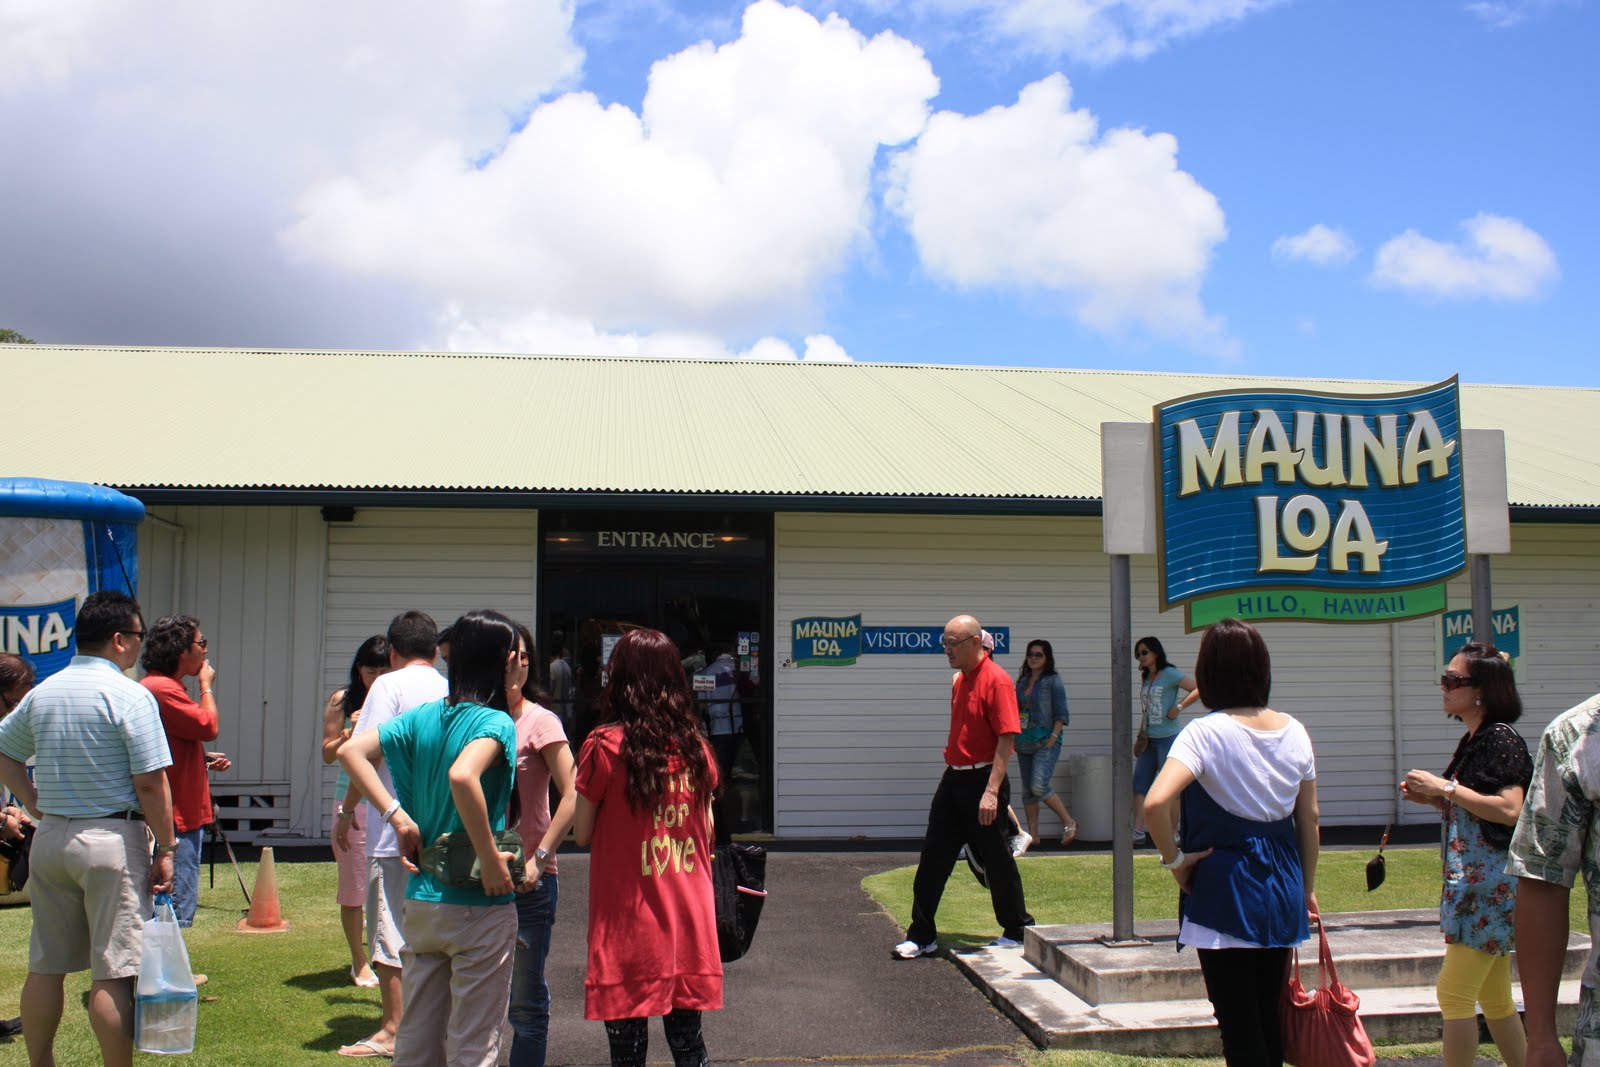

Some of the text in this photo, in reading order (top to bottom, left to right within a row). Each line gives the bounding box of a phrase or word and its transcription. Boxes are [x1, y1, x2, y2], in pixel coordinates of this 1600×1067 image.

[1175, 408, 1456, 498] MAUNA
[597, 531, 716, 548] ENTRANCE
[1255, 493, 1389, 574] LOA
[1237, 595, 1406, 616] HILO, HAWAII
[0, 611, 72, 654] NA
[796, 620, 859, 640] MAUNA
[1446, 613, 1517, 638] MANA
[812, 638, 843, 656] LOA
[865, 632, 932, 648] VISITOR
